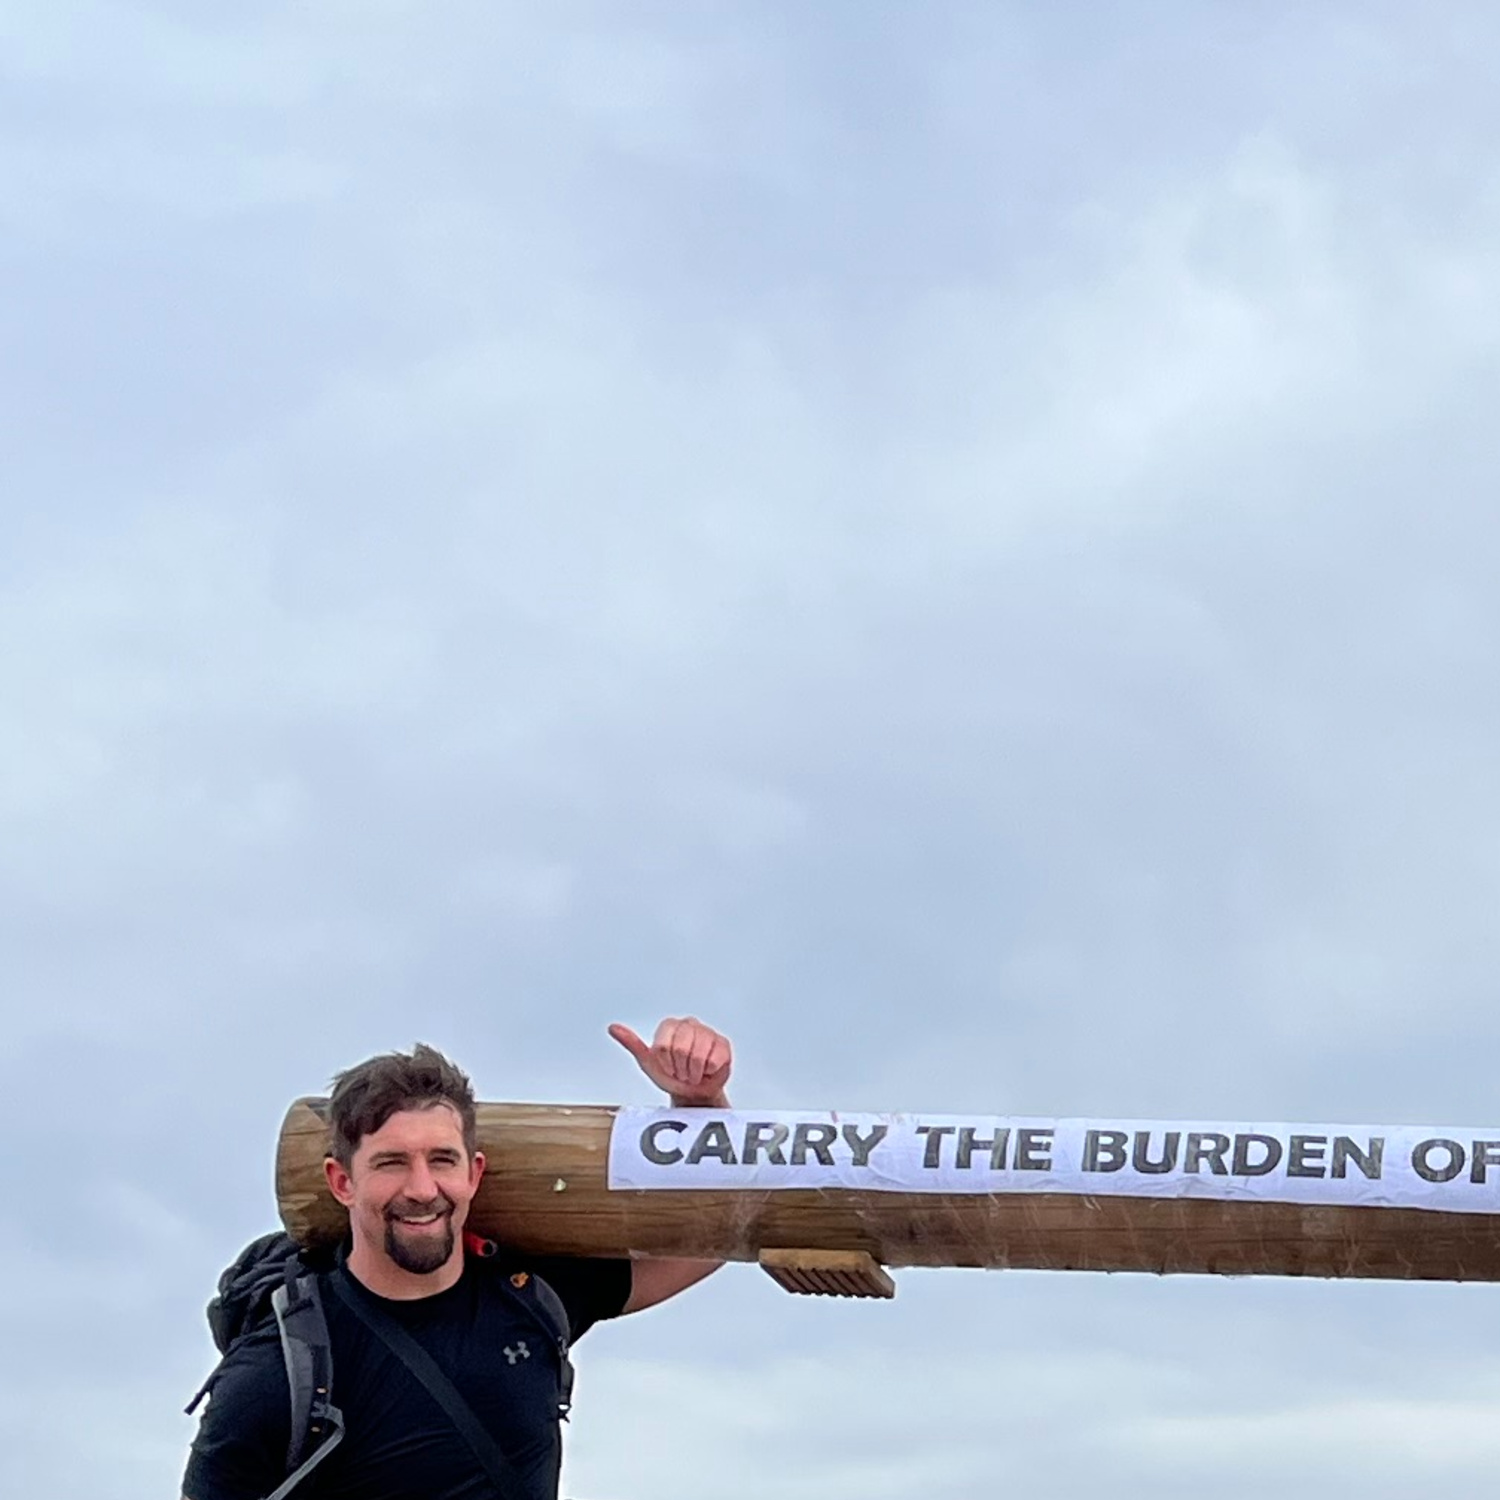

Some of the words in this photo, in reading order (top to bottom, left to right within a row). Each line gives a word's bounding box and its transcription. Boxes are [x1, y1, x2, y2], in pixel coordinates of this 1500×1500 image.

[640, 1120, 888, 1167] CARRY
[917, 1126, 1054, 1172] THE
[1081, 1130, 1384, 1180] BURDEN
